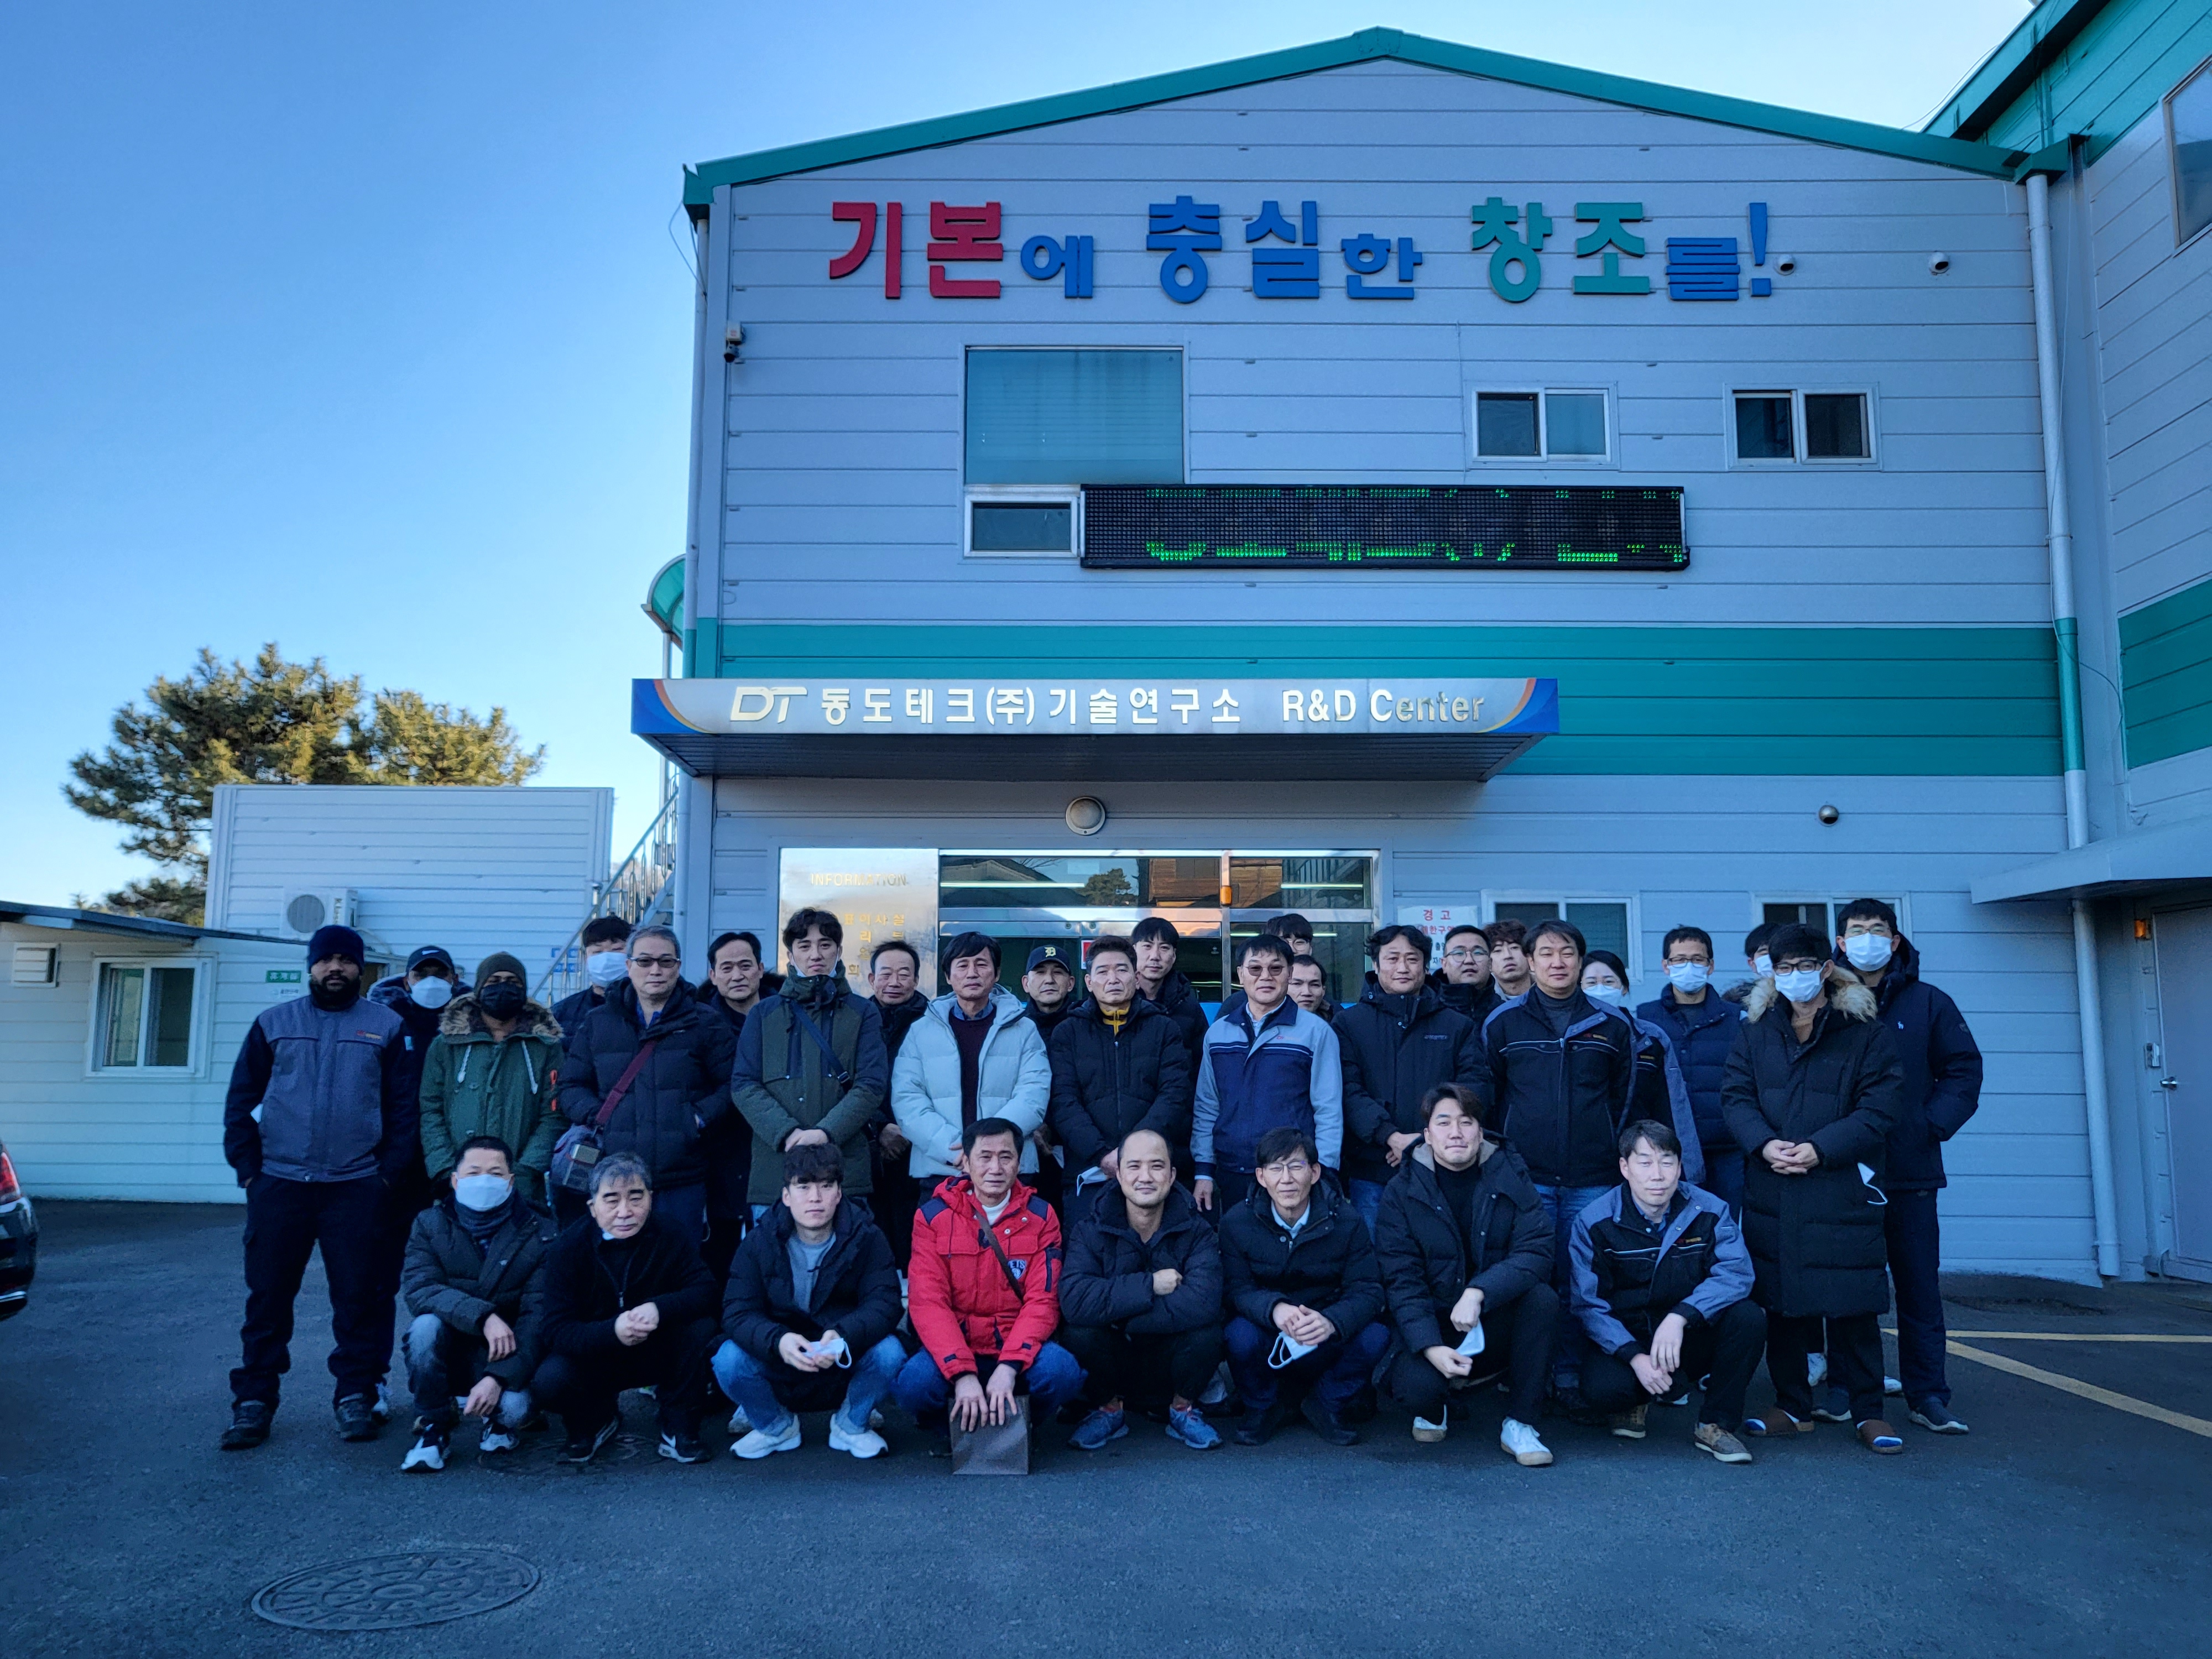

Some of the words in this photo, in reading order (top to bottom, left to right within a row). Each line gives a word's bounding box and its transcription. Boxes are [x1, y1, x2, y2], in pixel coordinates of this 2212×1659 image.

[829, 201, 1094, 299] 기본에
[1146, 196, 1423, 304] 충실한
[1471, 197, 1772, 302] 창조를!
[730, 686, 808, 723] DT
[1282, 690, 1356, 721] R&D
[1370, 689, 1484, 722] Center
[811, 873, 906, 886] INFORMATION
[837, 914, 905, 926] 표이사실
